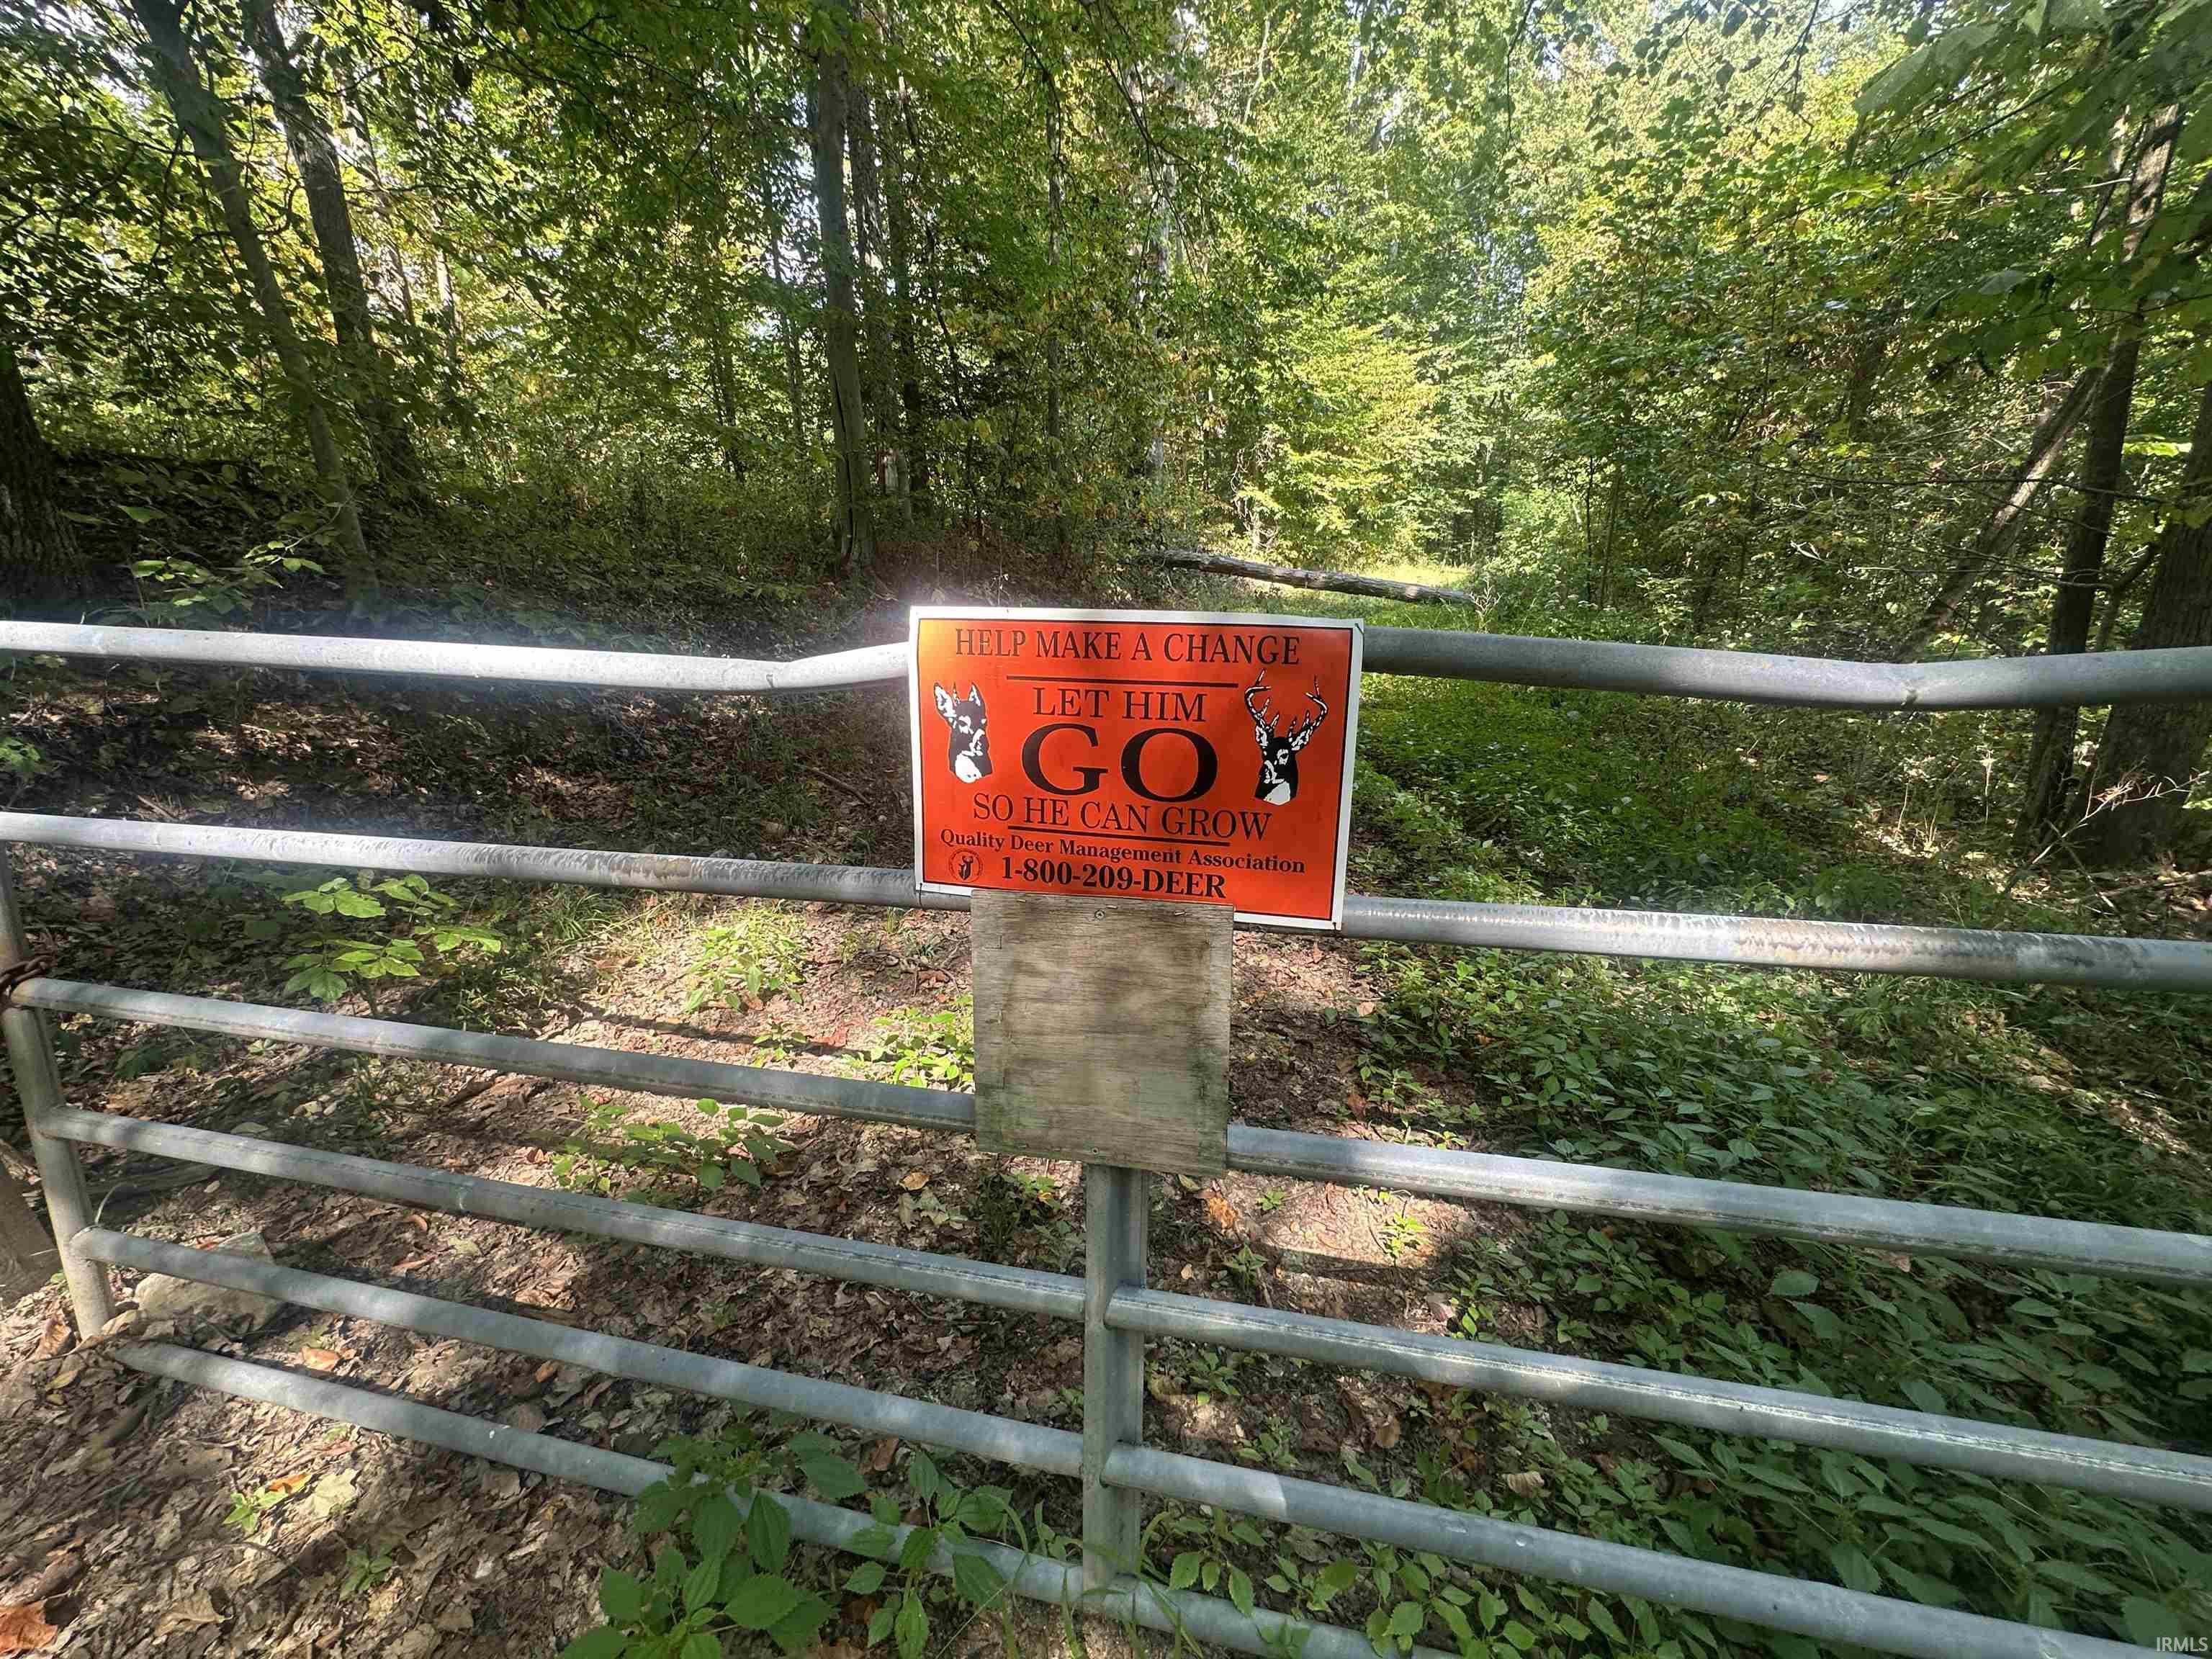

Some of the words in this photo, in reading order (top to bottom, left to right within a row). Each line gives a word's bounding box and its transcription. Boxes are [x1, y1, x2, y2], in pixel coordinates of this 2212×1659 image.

[956, 628, 1027, 657] HELP
[1036, 631, 1121, 660] MAKE
[1130, 632, 1153, 661] A
[1164, 633, 1300, 665] CHANGE
[1033, 687, 1110, 718] LET
[1122, 691, 1208, 721] HIM
[1021, 723, 1218, 802] GO
[973, 793, 1014, 821] SO
[1024, 797, 1069, 826] HE
[1080, 801, 1151, 831] CAN
[1161, 806, 1272, 841] GROW
[940, 830, 1005, 851] Quality
[1010, 836, 1054, 853] Deer
[1059, 840, 1182, 864] Management
[1190, 850, 1305, 873] Association
[1002, 857, 1226, 898] 1-800-209-DEER
